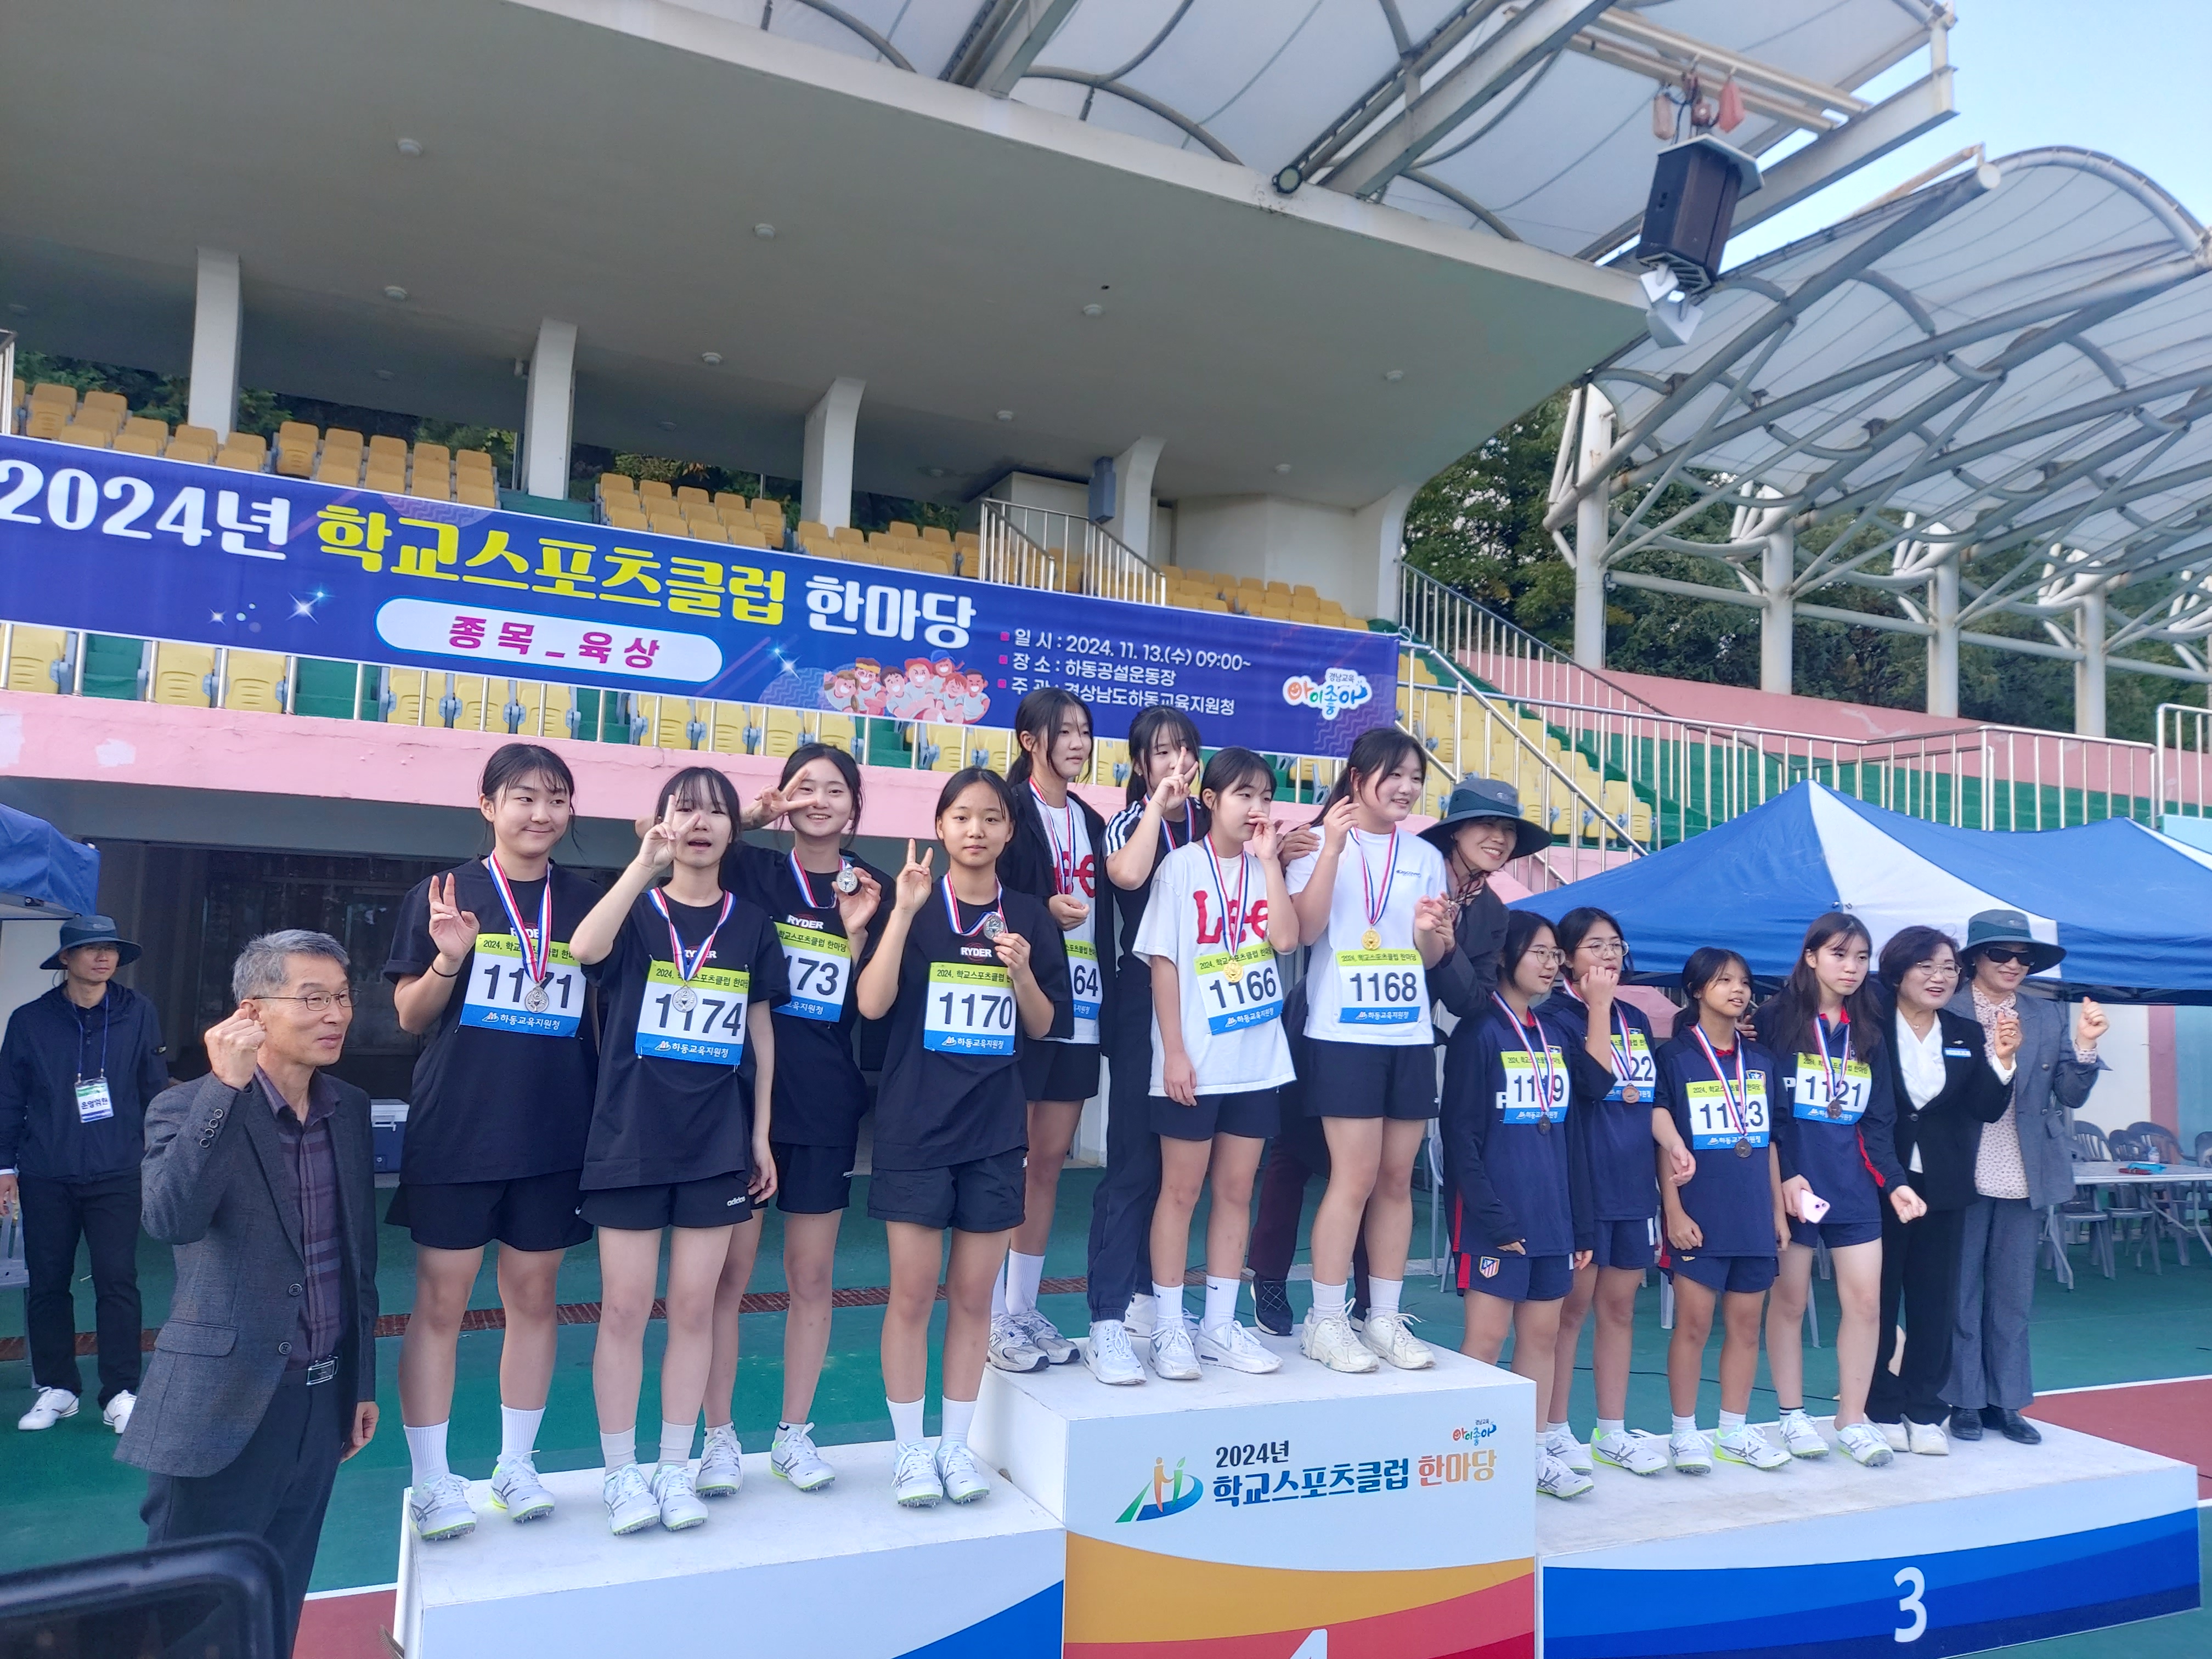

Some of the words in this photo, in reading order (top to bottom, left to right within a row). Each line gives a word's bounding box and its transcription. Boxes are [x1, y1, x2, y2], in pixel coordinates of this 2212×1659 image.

[0, 460, 290, 561] 2024년
[317, 504, 786, 625] 학교스포츠클럽
[806, 574, 977, 650] 한마당
[1066, 635, 1114, 657] 2024.
[1120, 641, 1138, 659] 11.
[1195, 650, 1251, 671] 09:00~
[1065, 658, 1177, 687] 하동공설운동장
[1287, 680, 1368, 715] 아이좋아
[787, 914, 824, 929] RYDER
[483, 940, 503, 950] 2024.
[827, 940, 847, 952] 한마당
[961, 947, 992, 957] RYDER
[656, 968, 674, 979] 2024.
[1199, 961, 1215, 970] 2024.
[937, 969, 953, 978] 2024.
[956, 969, 1005, 983] 학교스포츠클럽
[1209, 967, 1277, 1009] 1166
[1350, 972, 1417, 1002] 1168
[939, 991, 1013, 1029] 1170
[500, 1014, 561, 1030] 하동교육지원청
[672, 1042, 729, 1058] 하동교육지원청
[957, 1037, 1004, 1049] 하동교육지원청
[727, 1196, 746, 1206] adidas
[1452, 1424, 1497, 1446] 아이좋아
[1215, 1440, 1289, 1469] 2024년
[1213, 1457, 1409, 1508] 학교스포츠클럽
[1418, 1449, 1497, 1487] 한마당
[1893, 1566, 1928, 1644] 3
